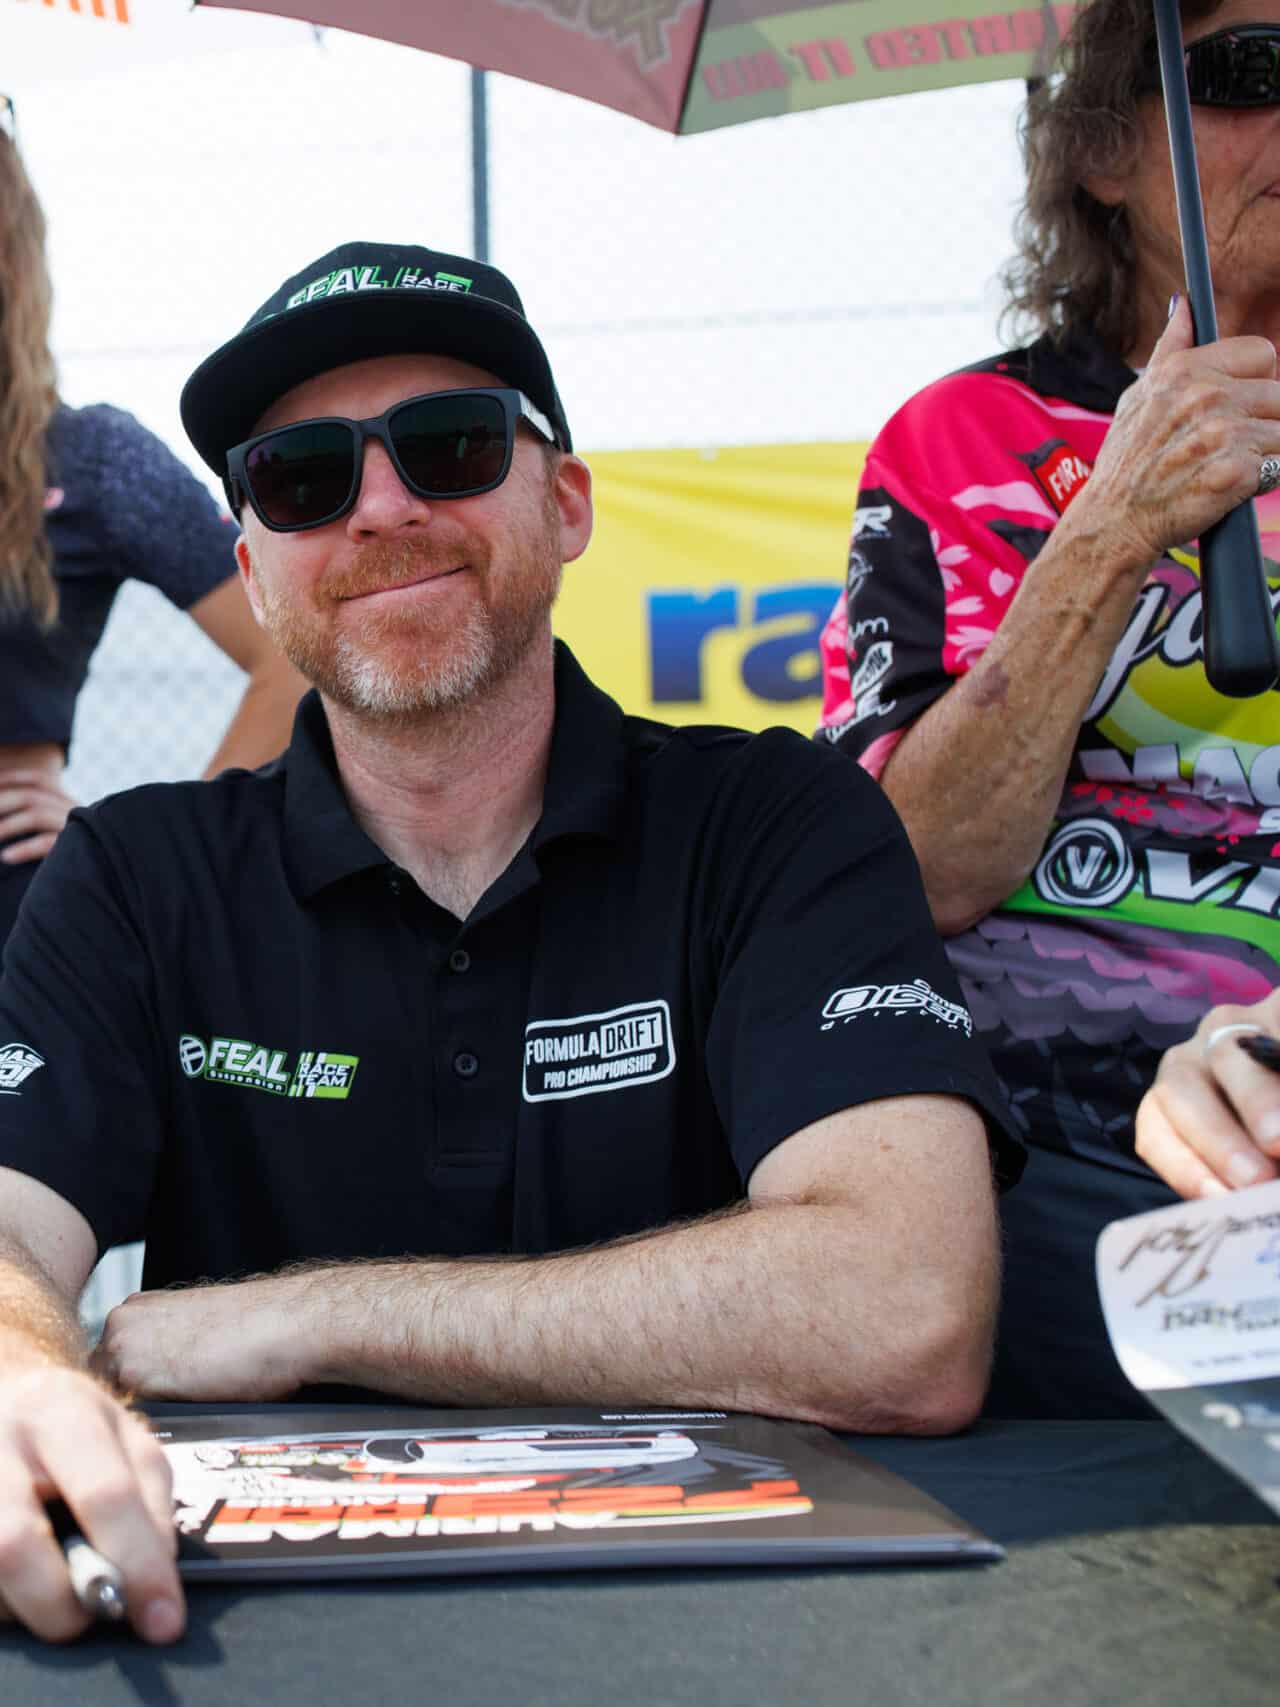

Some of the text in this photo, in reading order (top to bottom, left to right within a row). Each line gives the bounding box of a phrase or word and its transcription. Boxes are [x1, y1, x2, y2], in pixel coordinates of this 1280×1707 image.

[526, 1015, 659, 1067] FORMULA DRIFT
[208, 1040, 290, 1083] FEAL
[300, 1062, 351, 1076] RACE
[543, 1052, 657, 1089] PRO CHAMPIONSHIP
[296, 1073, 347, 1088] TEAM
